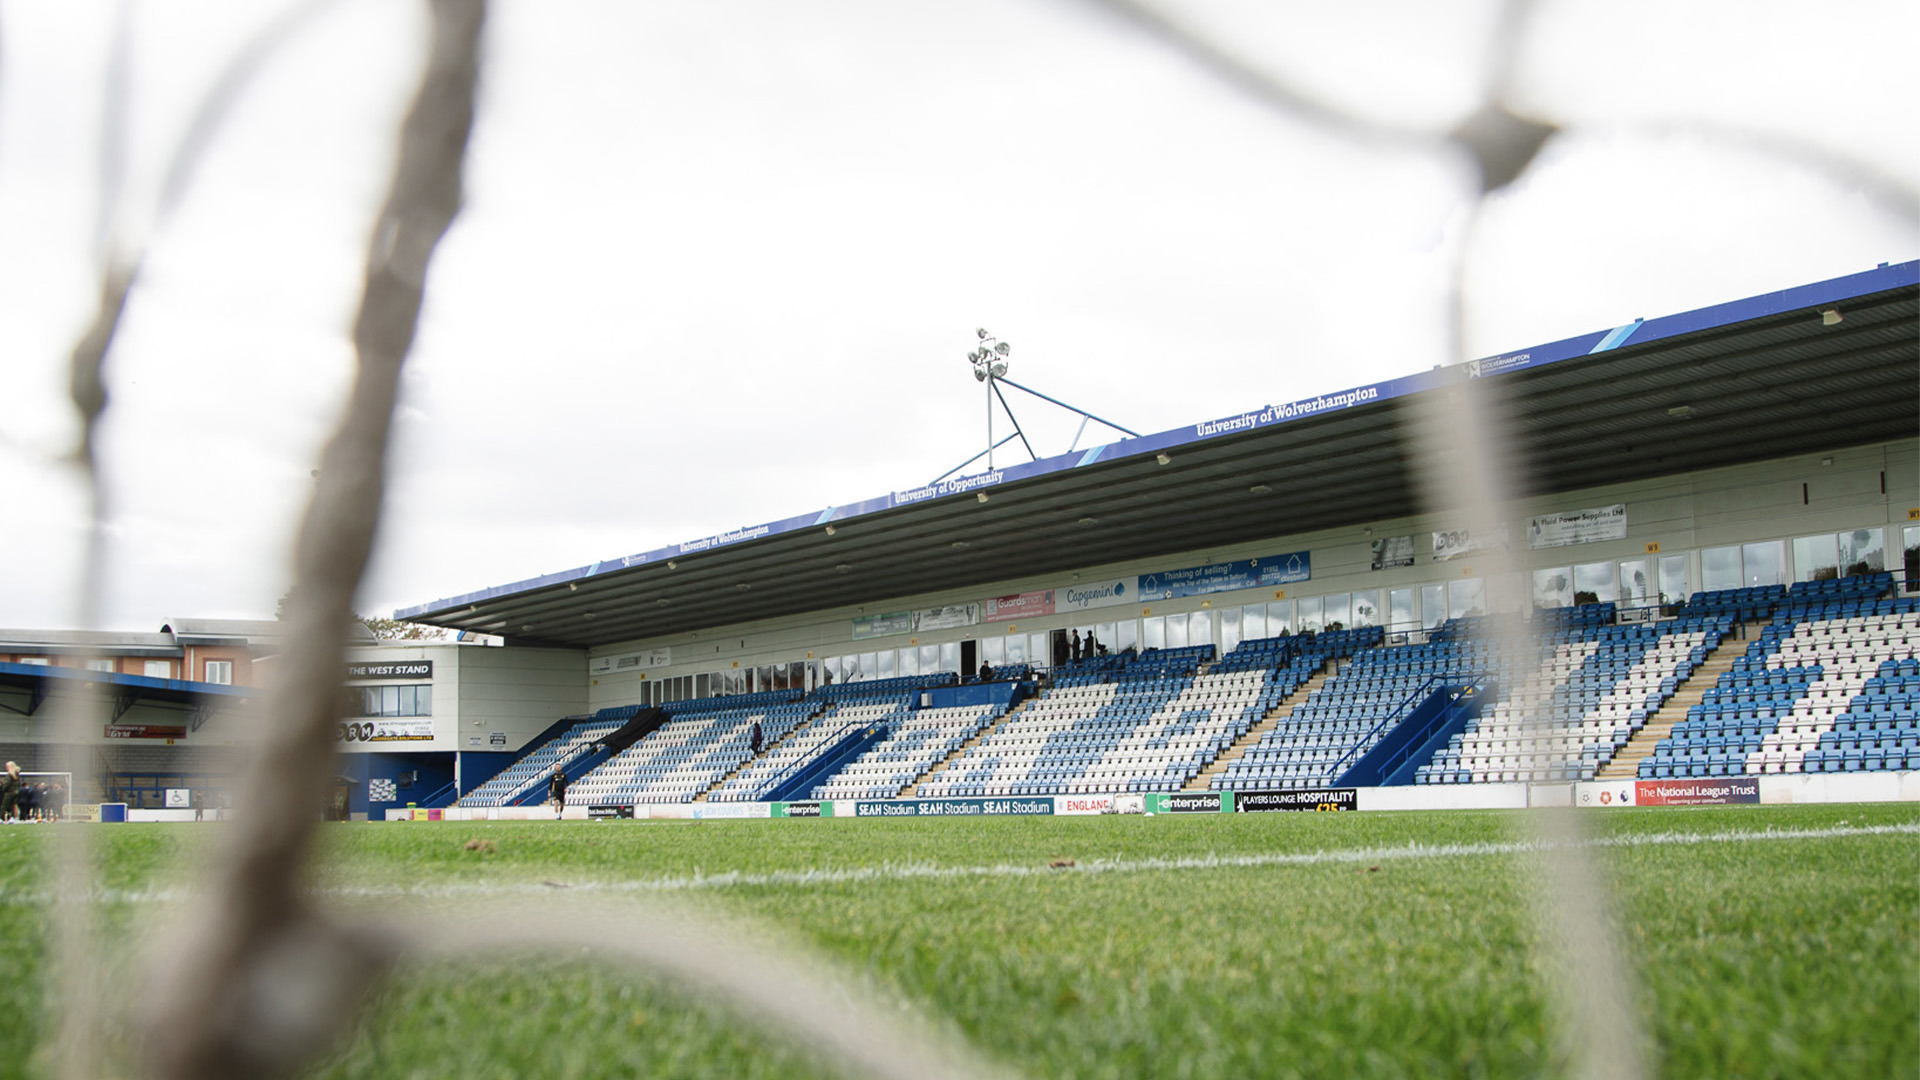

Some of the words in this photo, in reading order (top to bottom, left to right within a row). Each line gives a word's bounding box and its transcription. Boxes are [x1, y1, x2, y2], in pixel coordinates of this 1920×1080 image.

[1196, 413, 1257, 437] University
[1260, 406, 1273, 423] of
[1273, 387, 1378, 421] Wolverhampton
[894, 485, 938, 504] University
[938, 481, 949, 494] of
[949, 470, 1004, 493] Opportunity
[1541, 516, 1557, 527] Fluid
[1559, 514, 1581, 524] Power
[1582, 510, 1611, 522] Supplies
[1612, 507, 1624, 517] Ltd
[680, 537, 710, 553] University
[711, 535, 718, 546] of
[718, 525, 769, 544] Wolverhampton
[1164, 570, 1194, 581] Thinking
[1195, 568, 1202, 577] of
[1204, 563, 1233, 575] selling?
[998, 595, 1043, 609] Guardsman
[1067, 584, 1114, 607] Capgemini
[349, 667, 366, 675] THE
[368, 666, 395, 675] WEST
[395, 665, 429, 674] STAND
[1243, 795, 1269, 804] PLAYERS
[1269, 795, 1296, 804] LOUNGE
[1297, 791, 1355, 803] HOSPITALITY
[1639, 787, 1655, 798] The
[1656, 785, 1694, 797] National
[1696, 785, 1730, 798] League
[1730, 785, 1756, 796] Trust
[783, 805, 820, 816] enterprise
[858, 804, 882, 816] SEAH
[883, 803, 915, 816] Stadium
[918, 803, 943, 815] SEAH
[945, 802, 979, 815] Stadium
[983, 801, 1010, 814] SEAH
[1012, 800, 1050, 814] Stadium
[1160, 797, 1220, 810] enterprise
